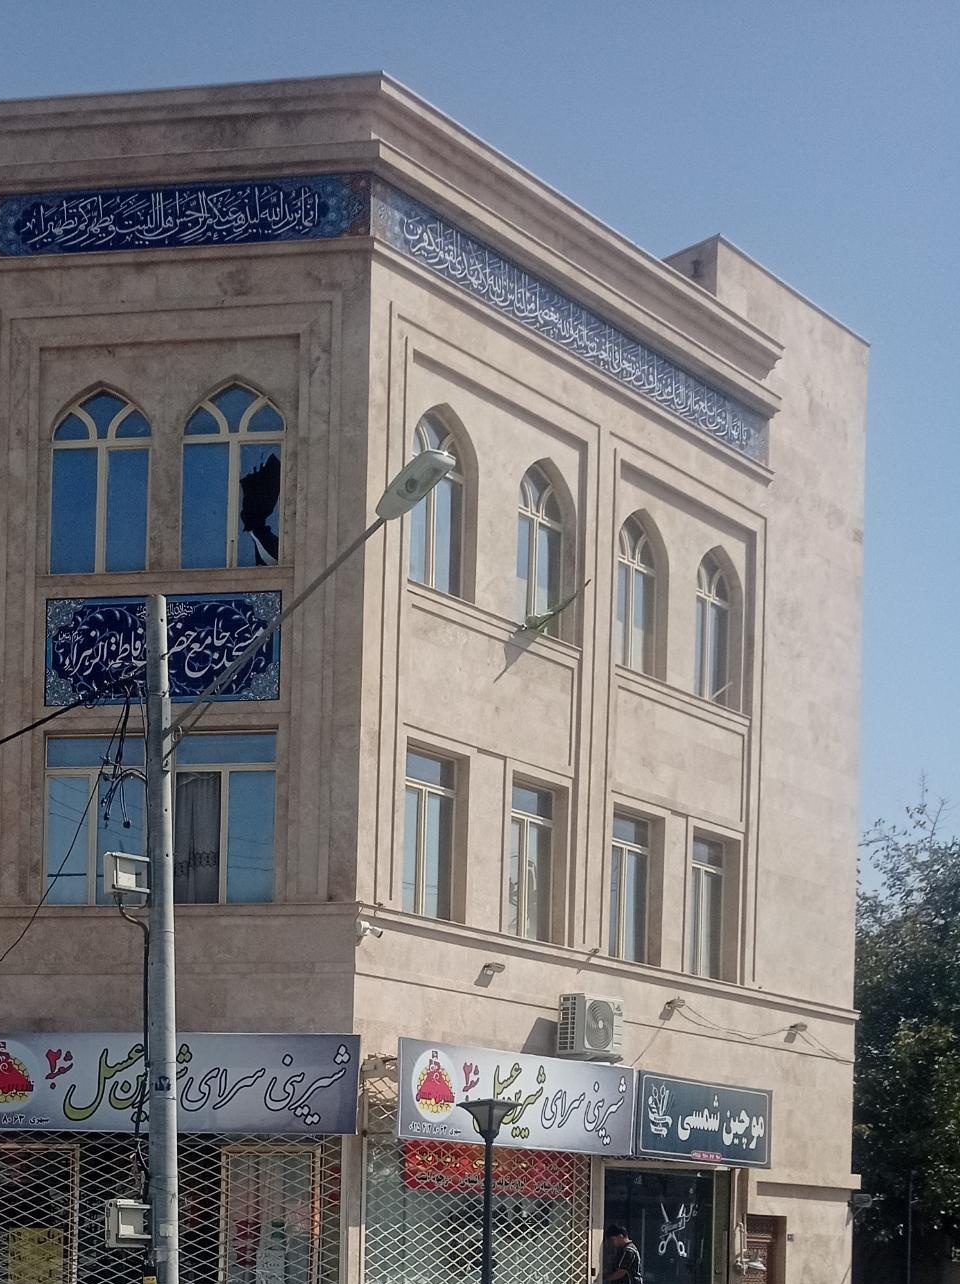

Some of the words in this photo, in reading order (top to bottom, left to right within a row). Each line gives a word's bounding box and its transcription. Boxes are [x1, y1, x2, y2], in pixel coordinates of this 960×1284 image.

[63, 1043, 146, 1122] عسل
[181, 1067, 266, 1111] سرای
[264, 1044, 350, 1125] شیرینی
[541, 1089, 585, 1130] سرای
[584, 1076, 627, 1146] شیرینی
[677, 1094, 720, 1141] شمسی
[723, 1110, 765, 1150] موچین
